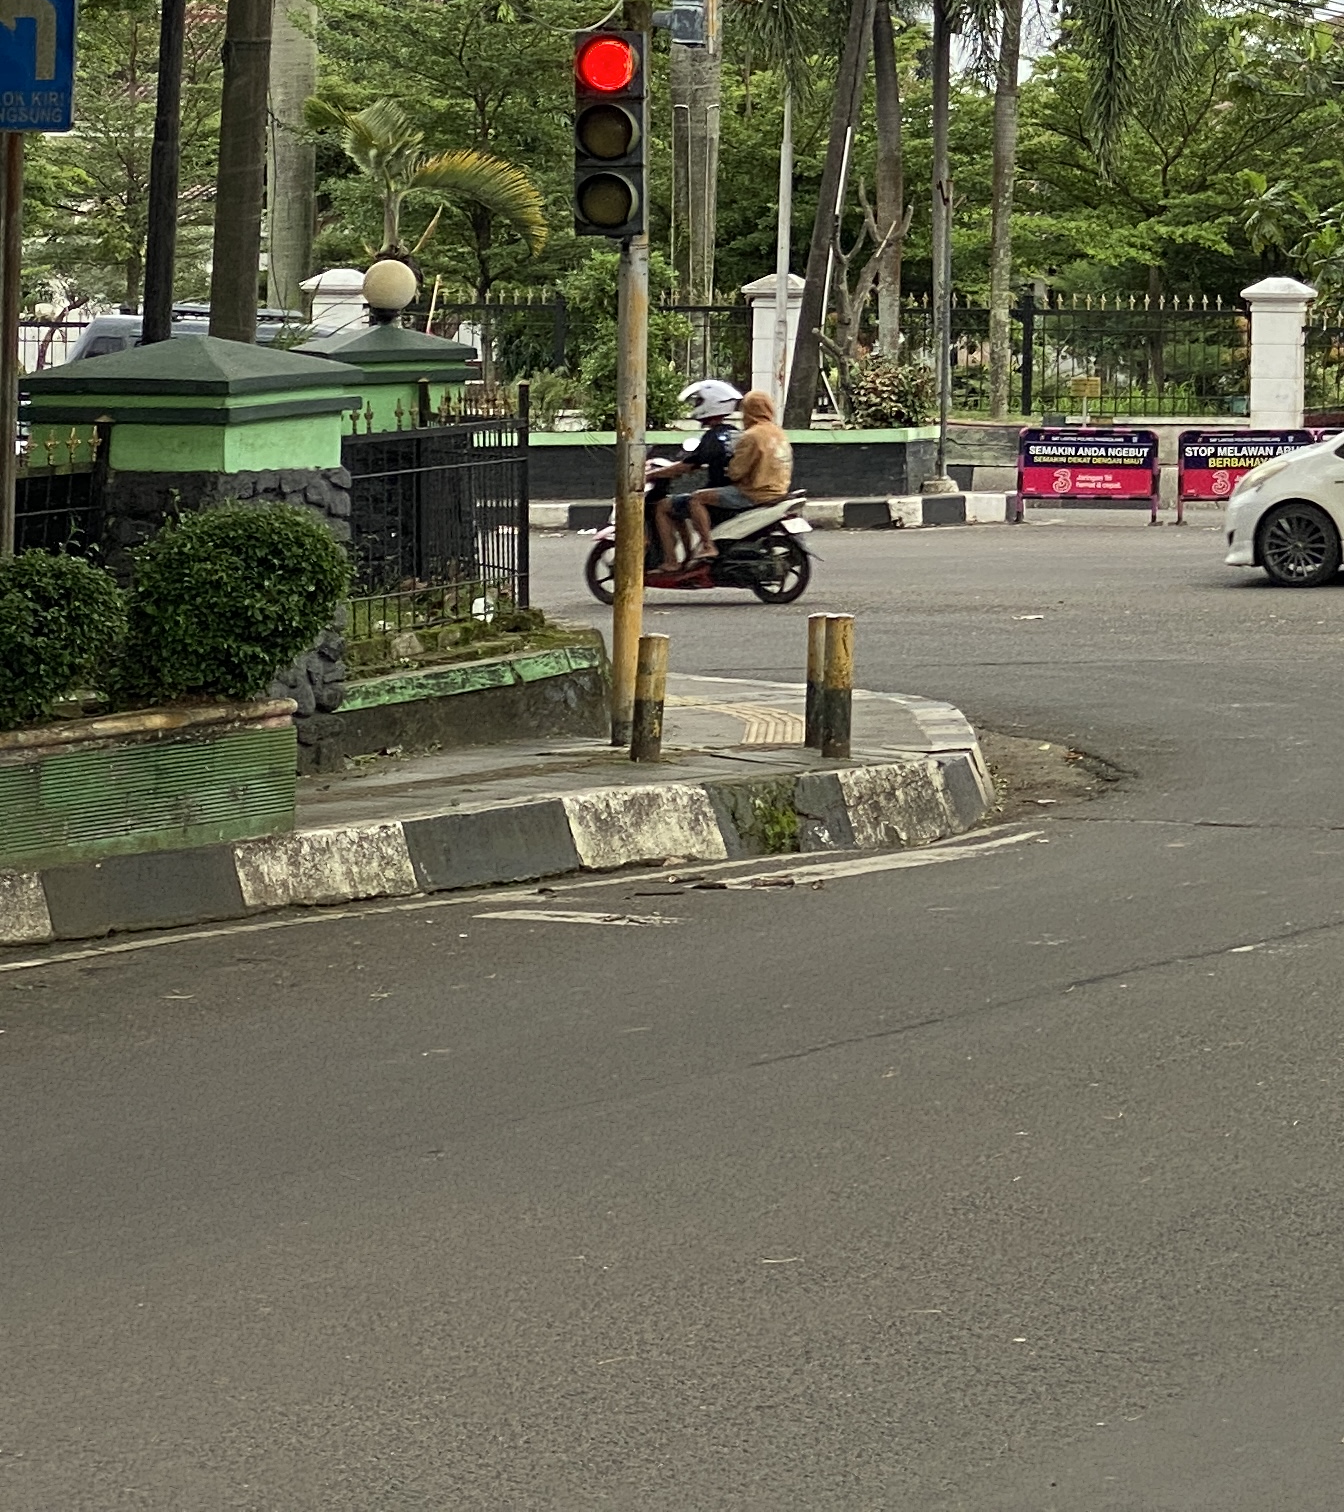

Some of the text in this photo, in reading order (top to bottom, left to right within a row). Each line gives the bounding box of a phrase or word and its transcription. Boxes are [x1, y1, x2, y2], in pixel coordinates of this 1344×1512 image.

[32, 91, 65, 106] KIRI
[1029, 446, 1150, 457] SEMAKIN ANDA NGEBUT
[1185, 447, 1215, 456] STOP
[1218, 446, 1273, 456] MELAWAN
